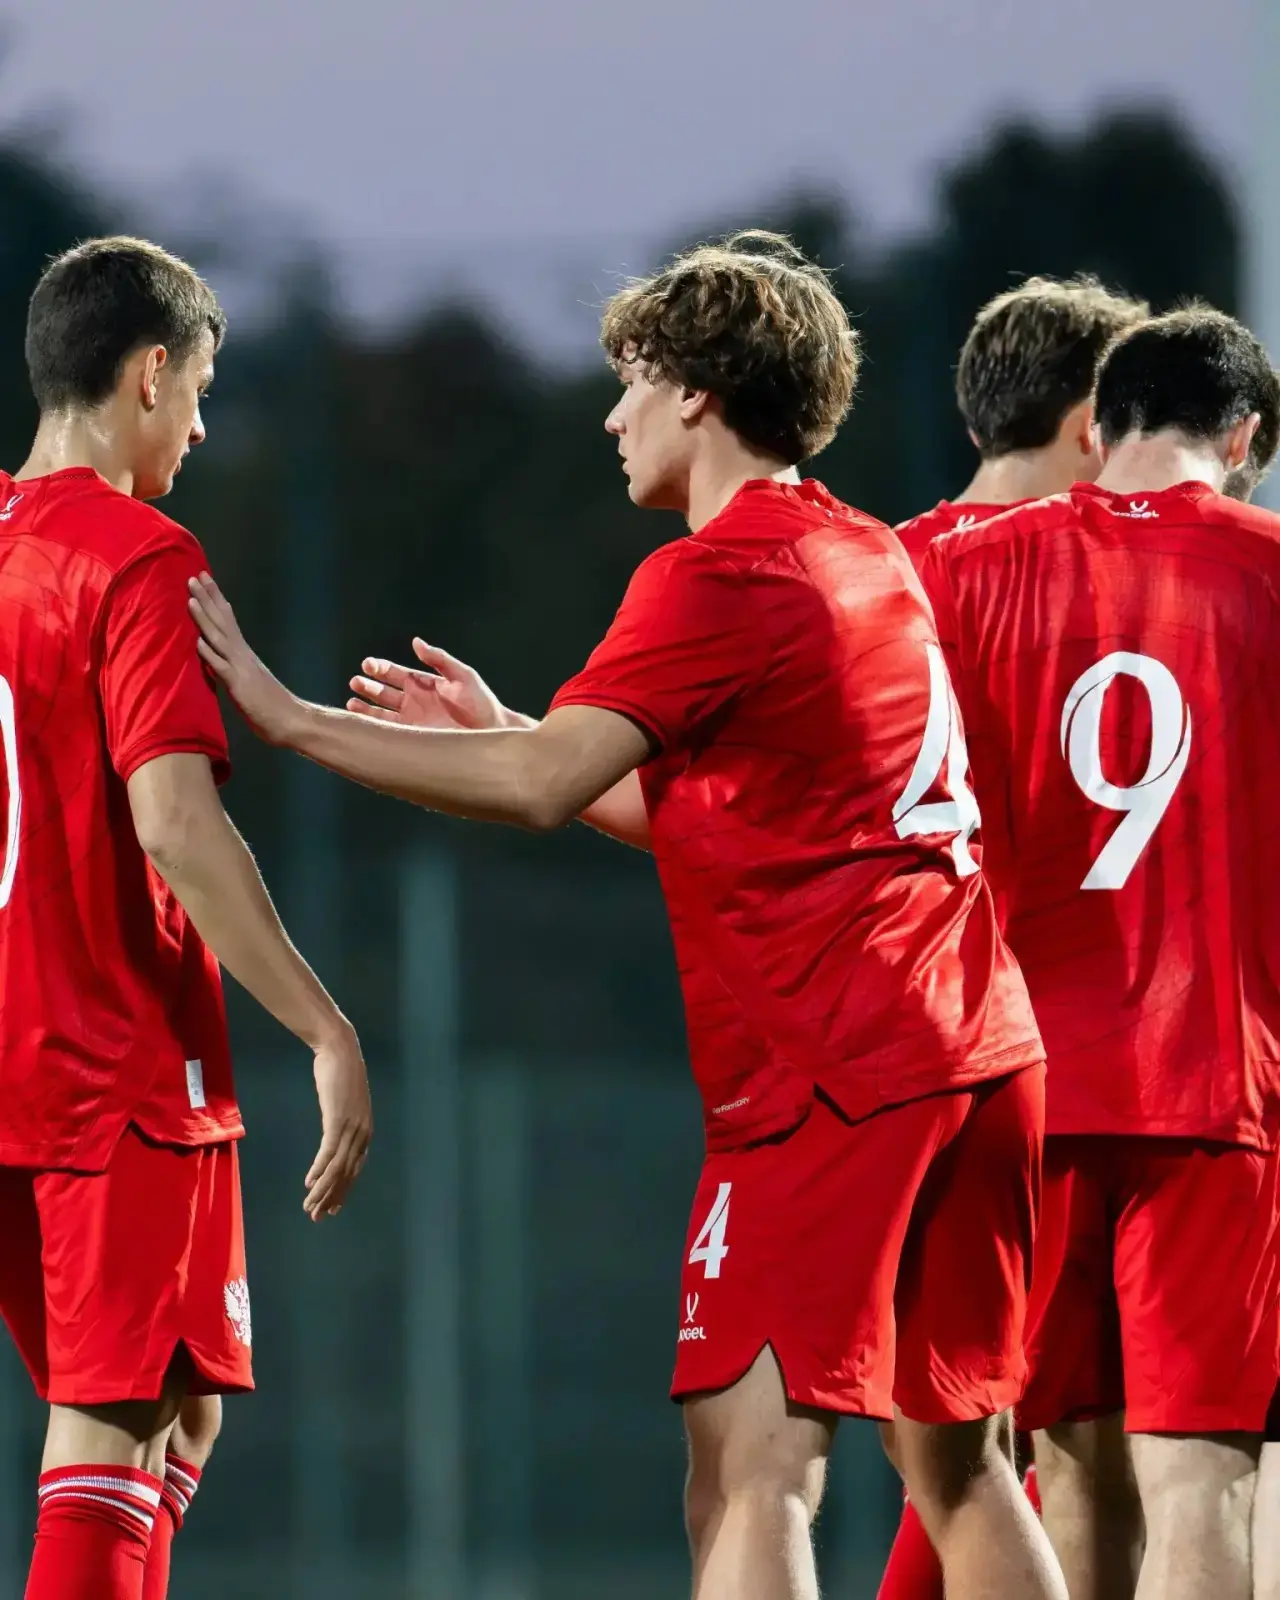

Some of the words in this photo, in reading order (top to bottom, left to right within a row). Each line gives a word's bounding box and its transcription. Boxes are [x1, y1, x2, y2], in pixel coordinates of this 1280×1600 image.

[892, 643, 982, 879] 4
[1060, 651, 1193, 891] 9
[688, 1181, 733, 1279] 4
